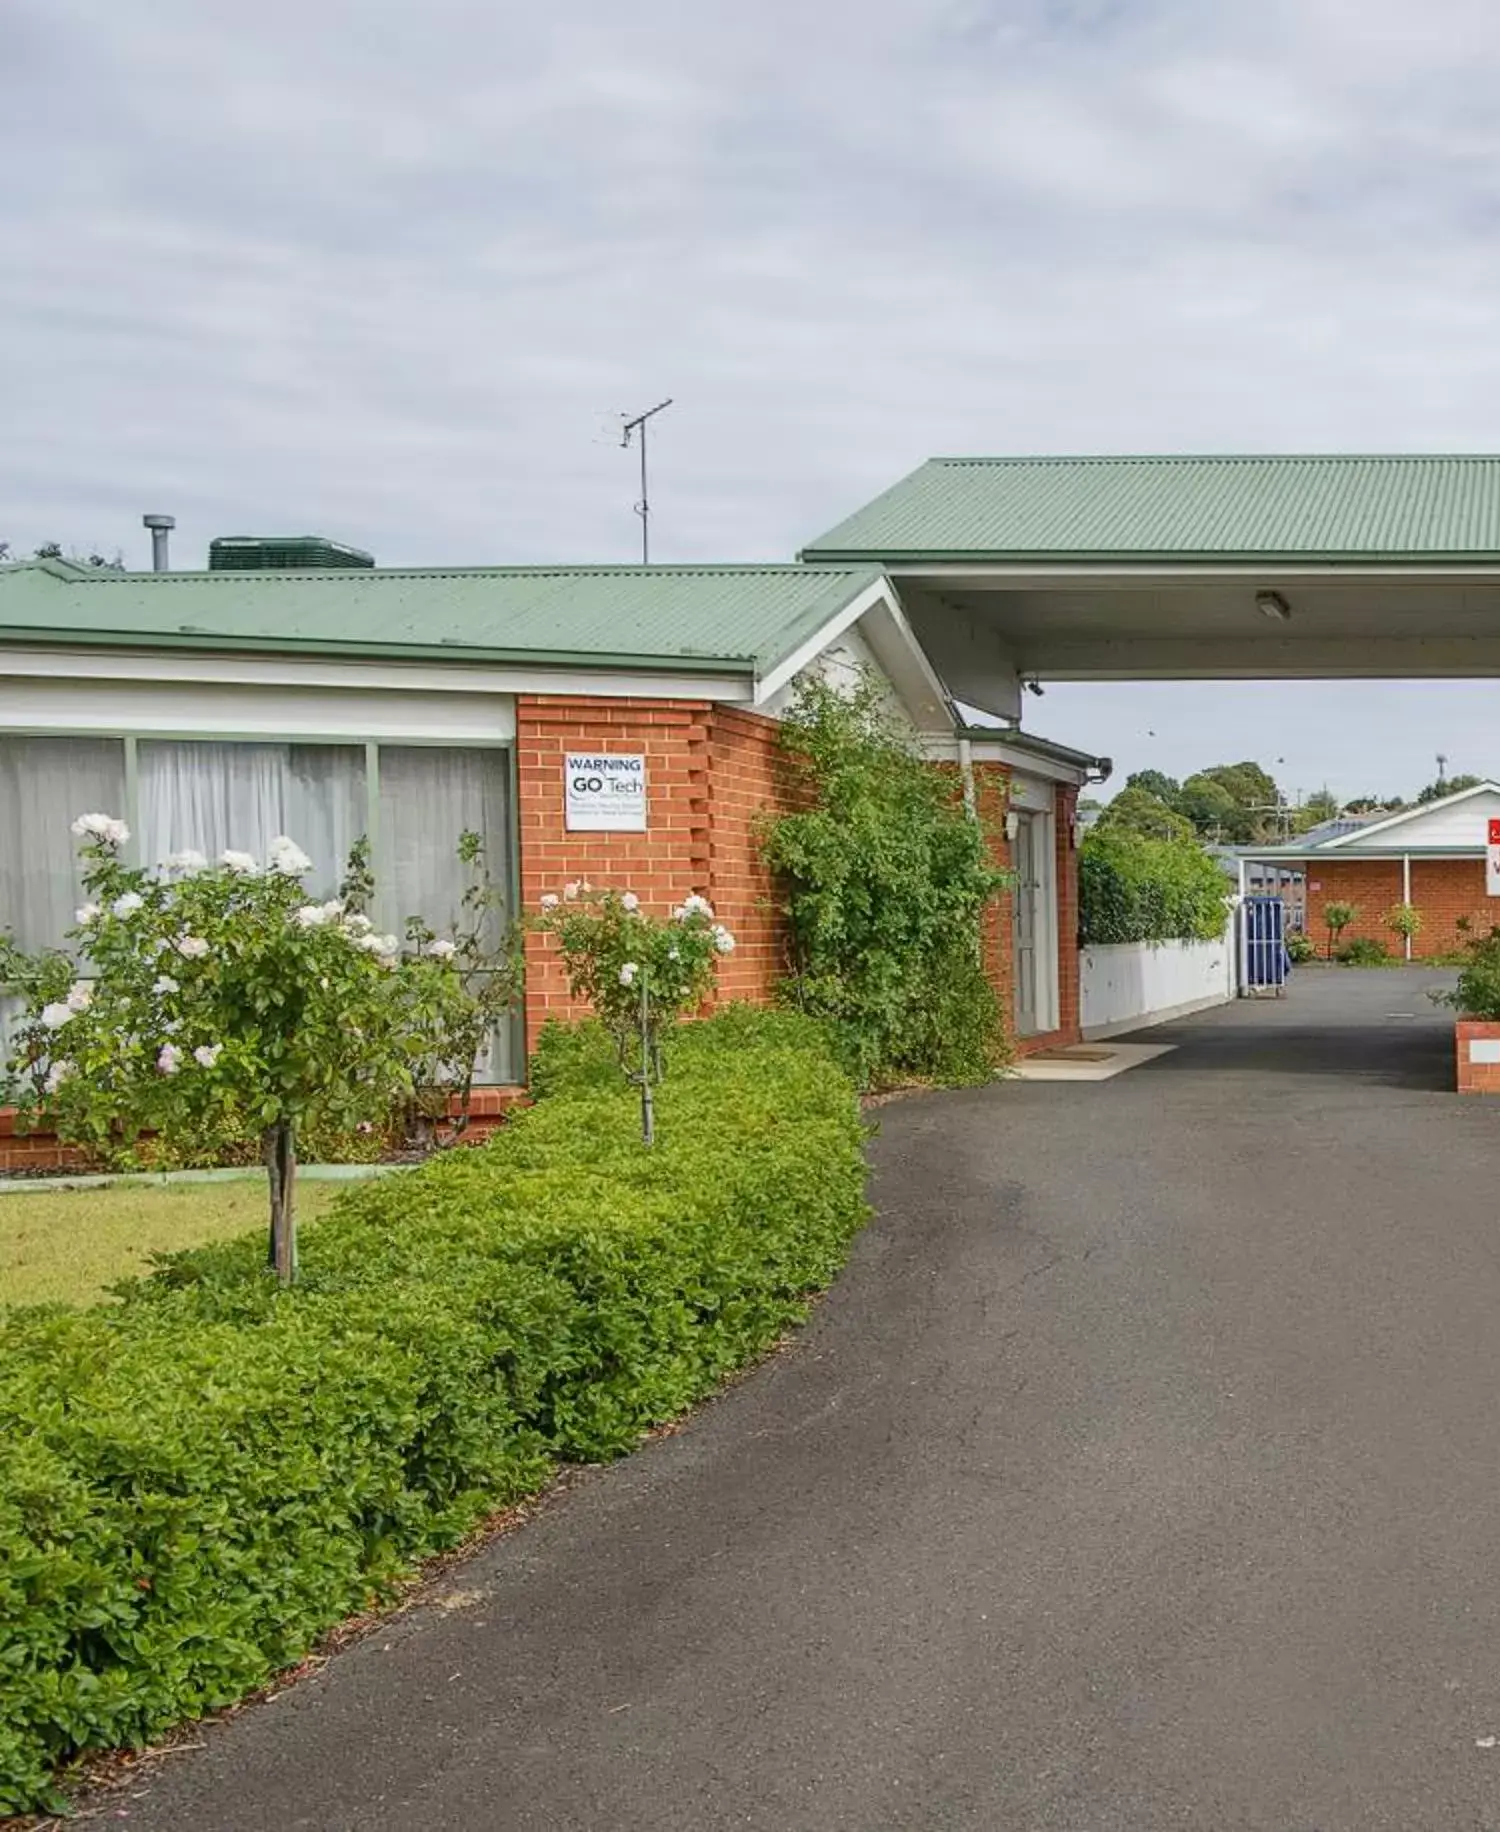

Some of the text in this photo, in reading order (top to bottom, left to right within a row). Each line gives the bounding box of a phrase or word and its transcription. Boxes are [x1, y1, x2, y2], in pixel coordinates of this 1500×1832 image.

[568, 758, 641, 771] WARNING
[573, 777, 642, 792] GO Tech
